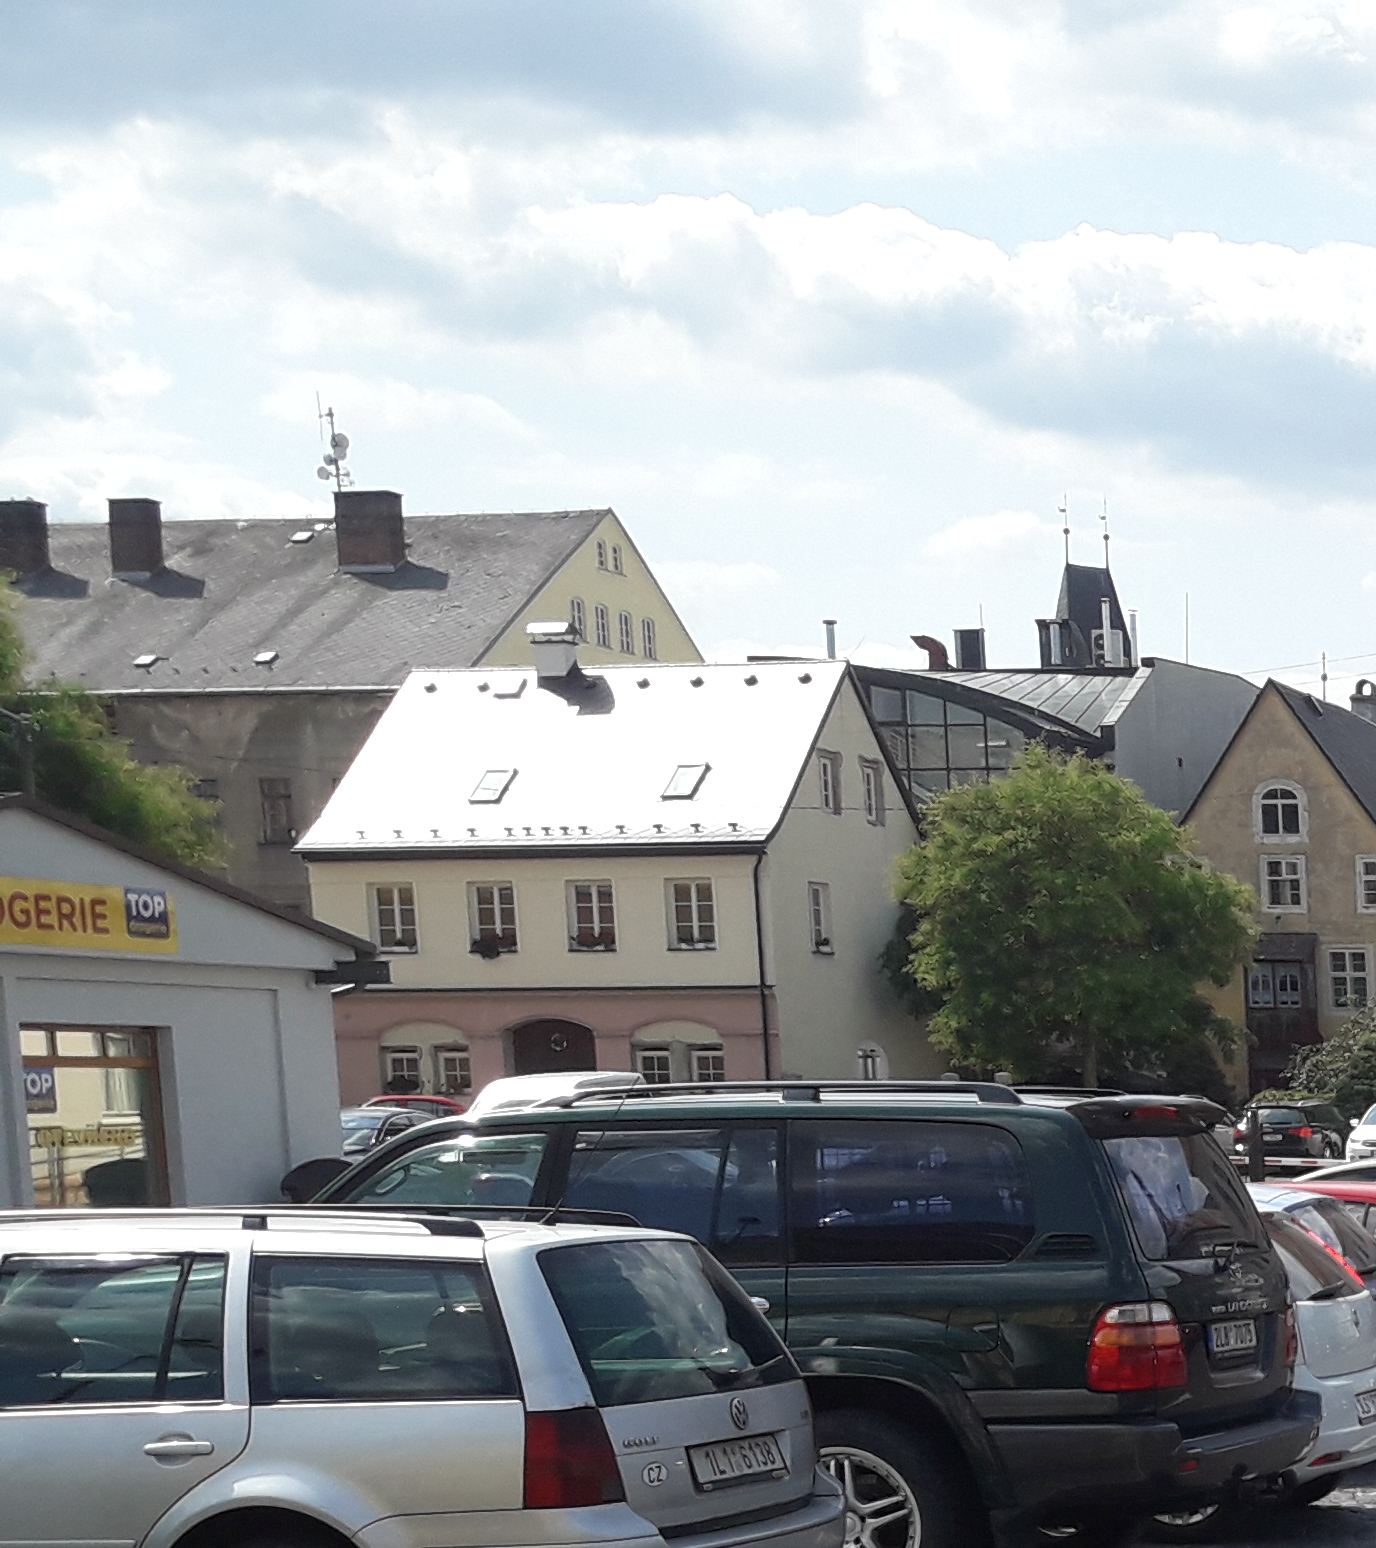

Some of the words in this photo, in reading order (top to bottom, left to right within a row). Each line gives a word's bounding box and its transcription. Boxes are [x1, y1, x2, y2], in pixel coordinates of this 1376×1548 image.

[0, 890, 111, 935] GERIE
[126, 893, 165, 918] TOP
[647, 1464, 664, 1484] CZ
